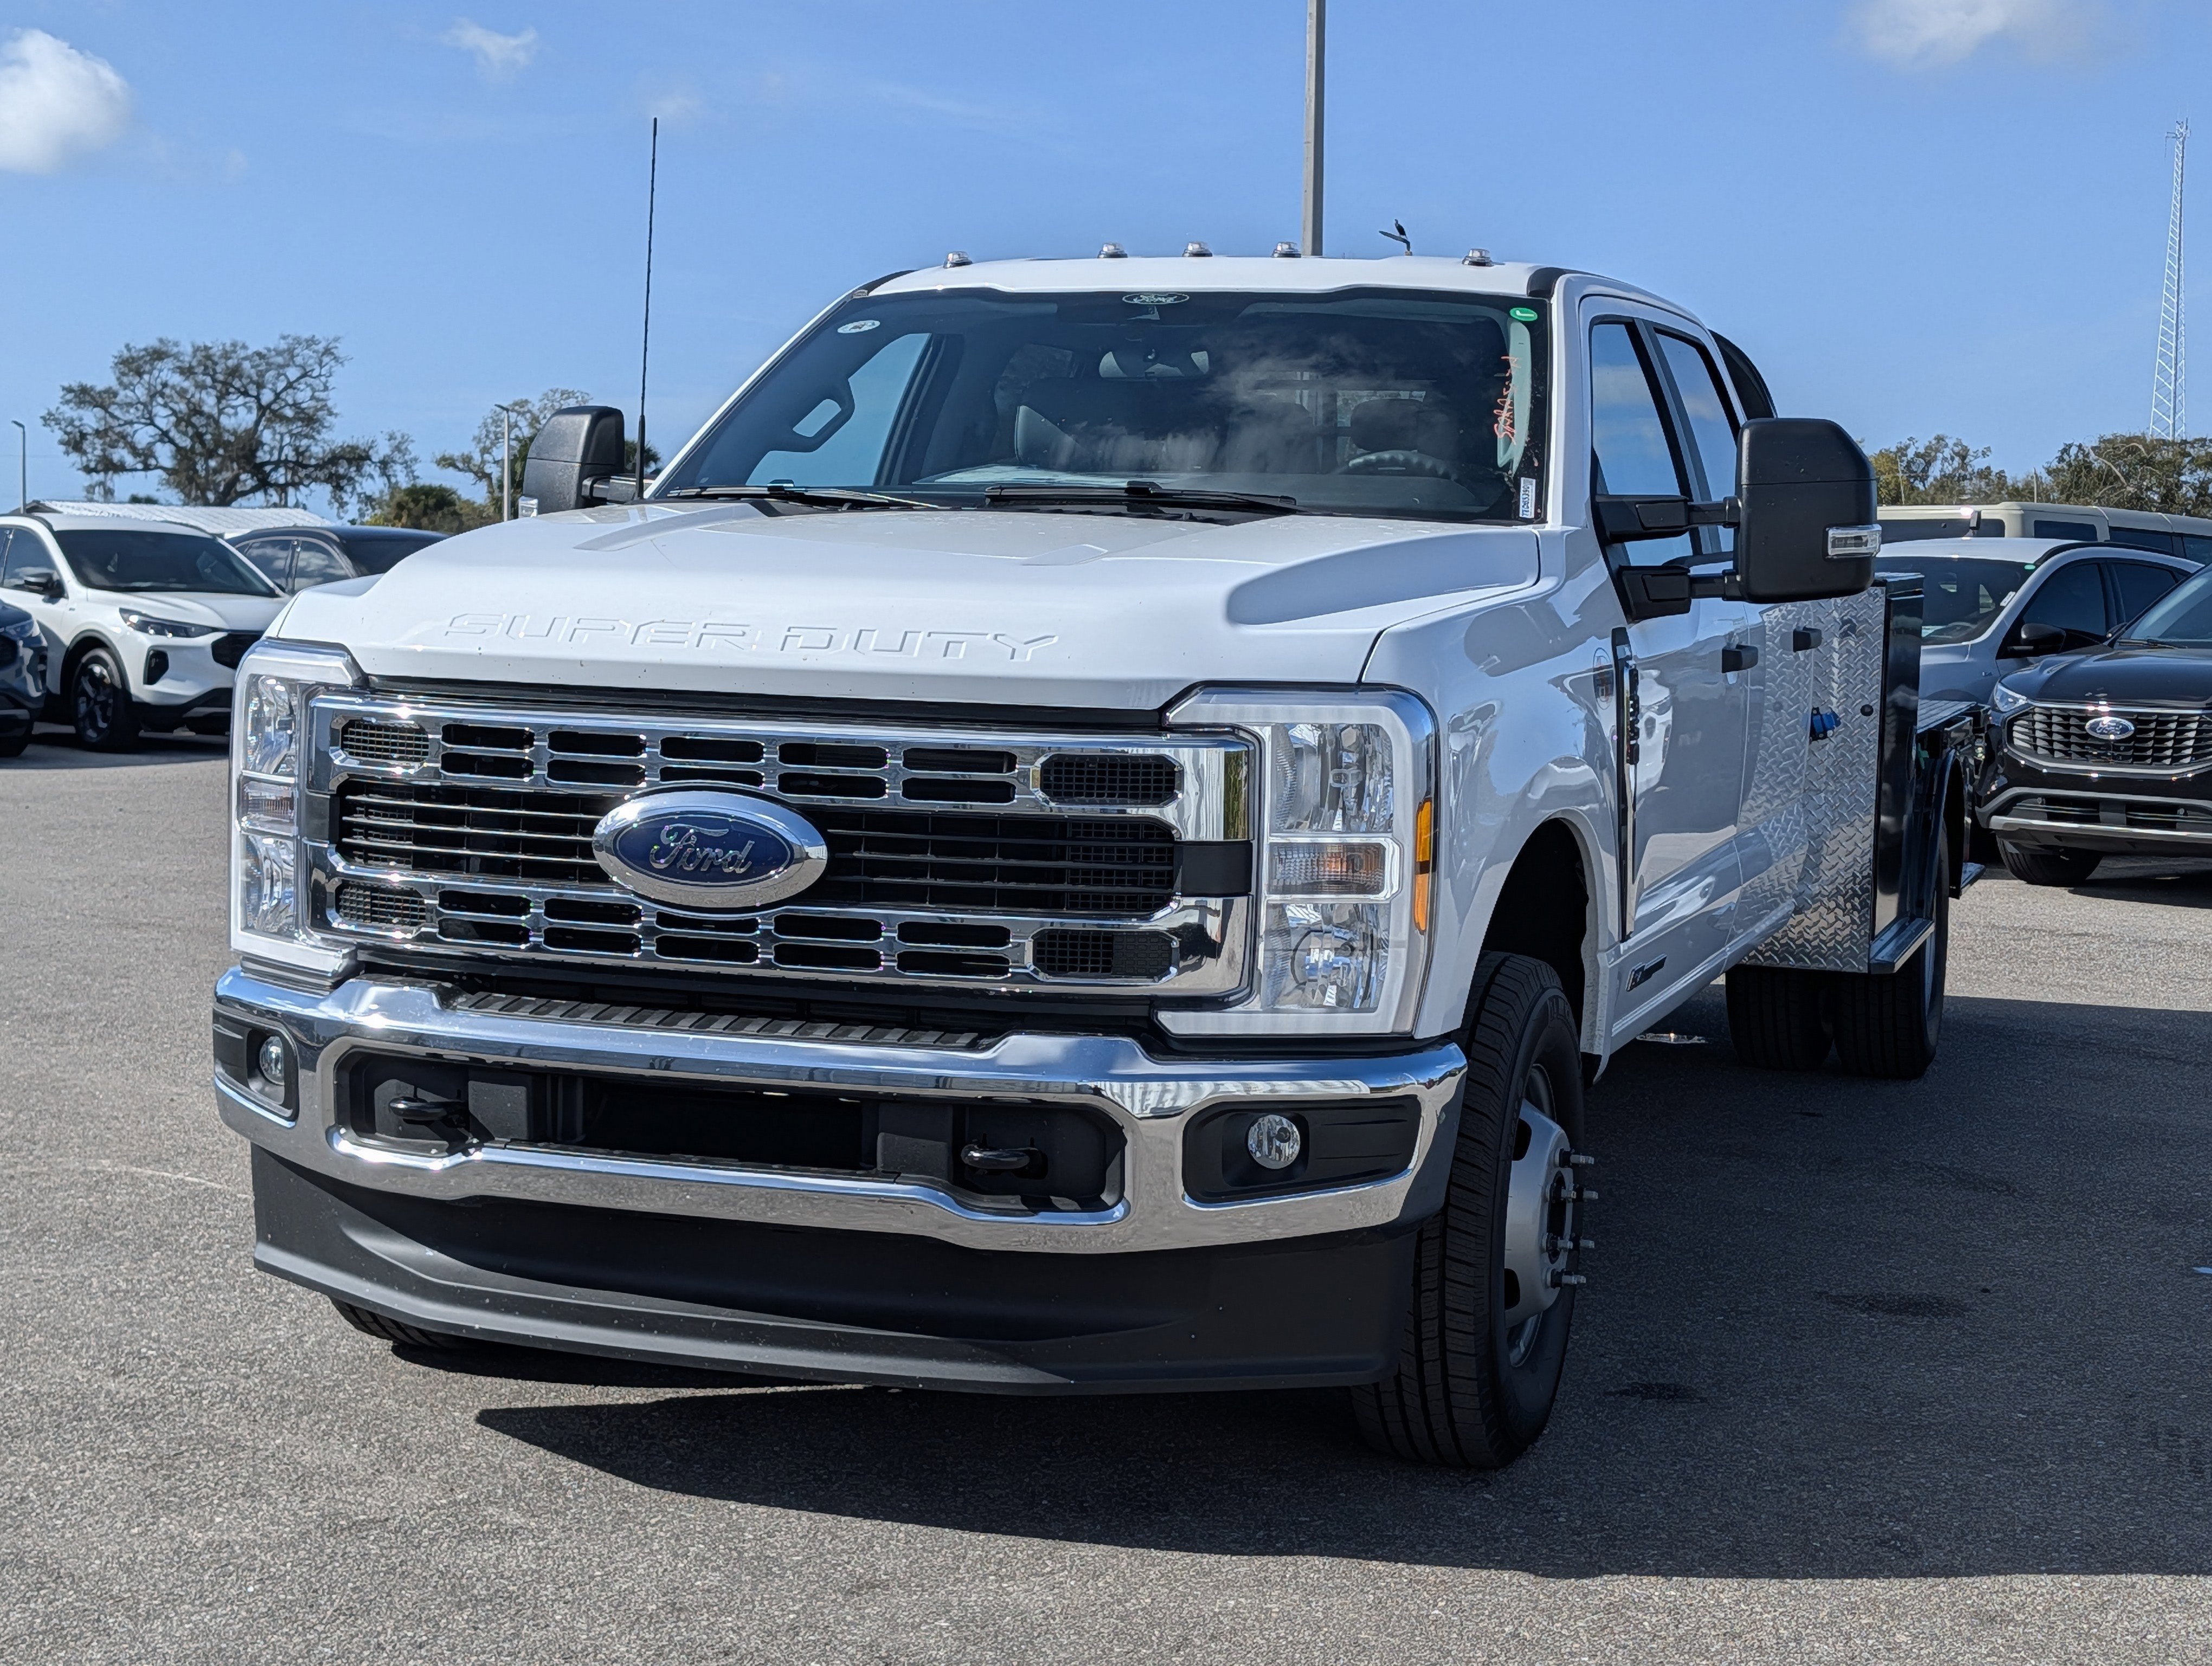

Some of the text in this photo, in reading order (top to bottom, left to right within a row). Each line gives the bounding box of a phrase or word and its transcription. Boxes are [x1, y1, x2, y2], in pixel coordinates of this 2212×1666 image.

[444, 613, 1059, 661] SUPER DUTY
[2095, 720, 2123, 734] Ford
[649, 823, 755, 874] Ford
